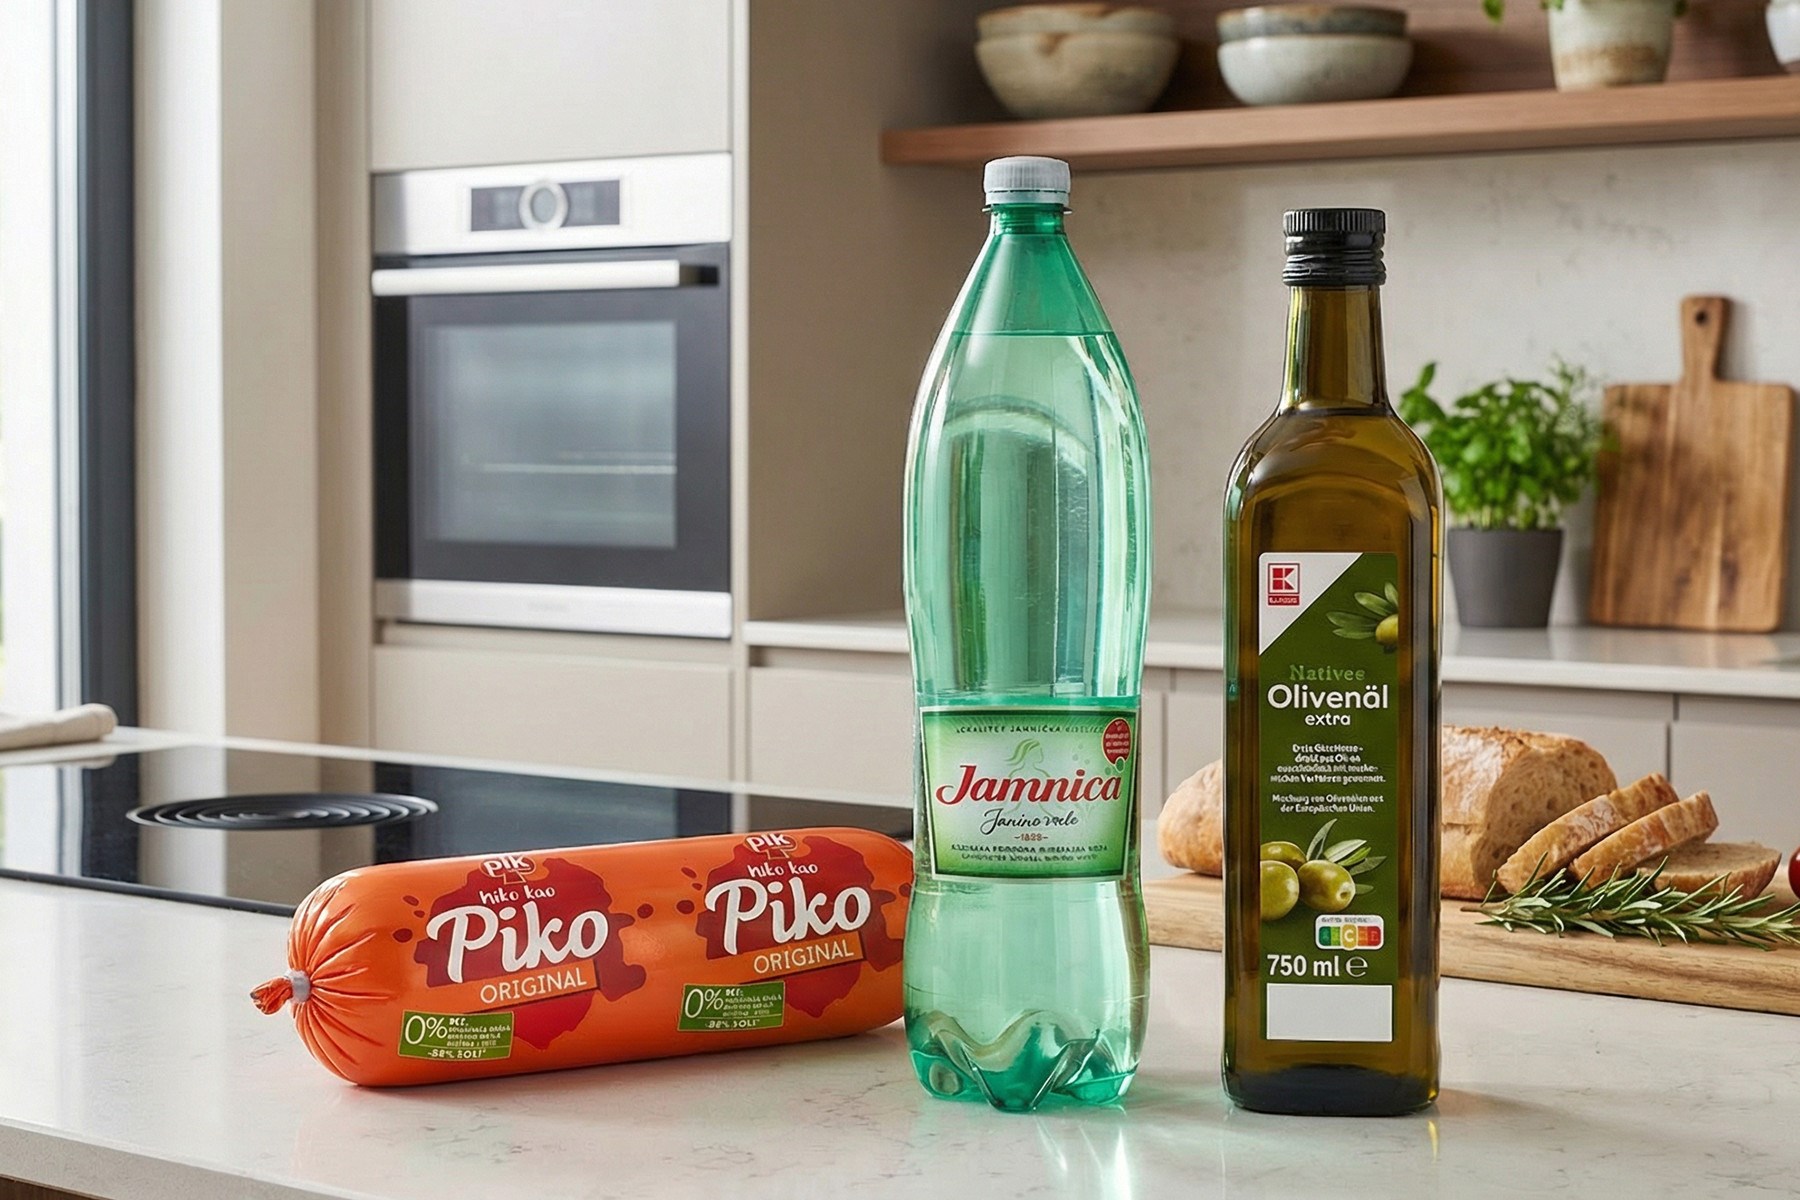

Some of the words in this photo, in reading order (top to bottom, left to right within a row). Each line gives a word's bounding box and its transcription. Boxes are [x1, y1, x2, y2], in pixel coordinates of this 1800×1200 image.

[1304, 712, 1351, 726] extra
[936, 765, 1122, 805] Jamnica
[788, 861, 818, 875] kao
[523, 884, 556, 900] kao
[704, 876, 871, 955] Piko
[426, 901, 609, 984] Piko
[753, 939, 854, 974] ORIGINAL
[1267, 954, 1307, 977] 750
[1313, 955, 1340, 977] ml
[480, 967, 588, 1004] ORIGINAL
[685, 988, 724, 1018] 0%
[405, 1015, 448, 1045] 0%
